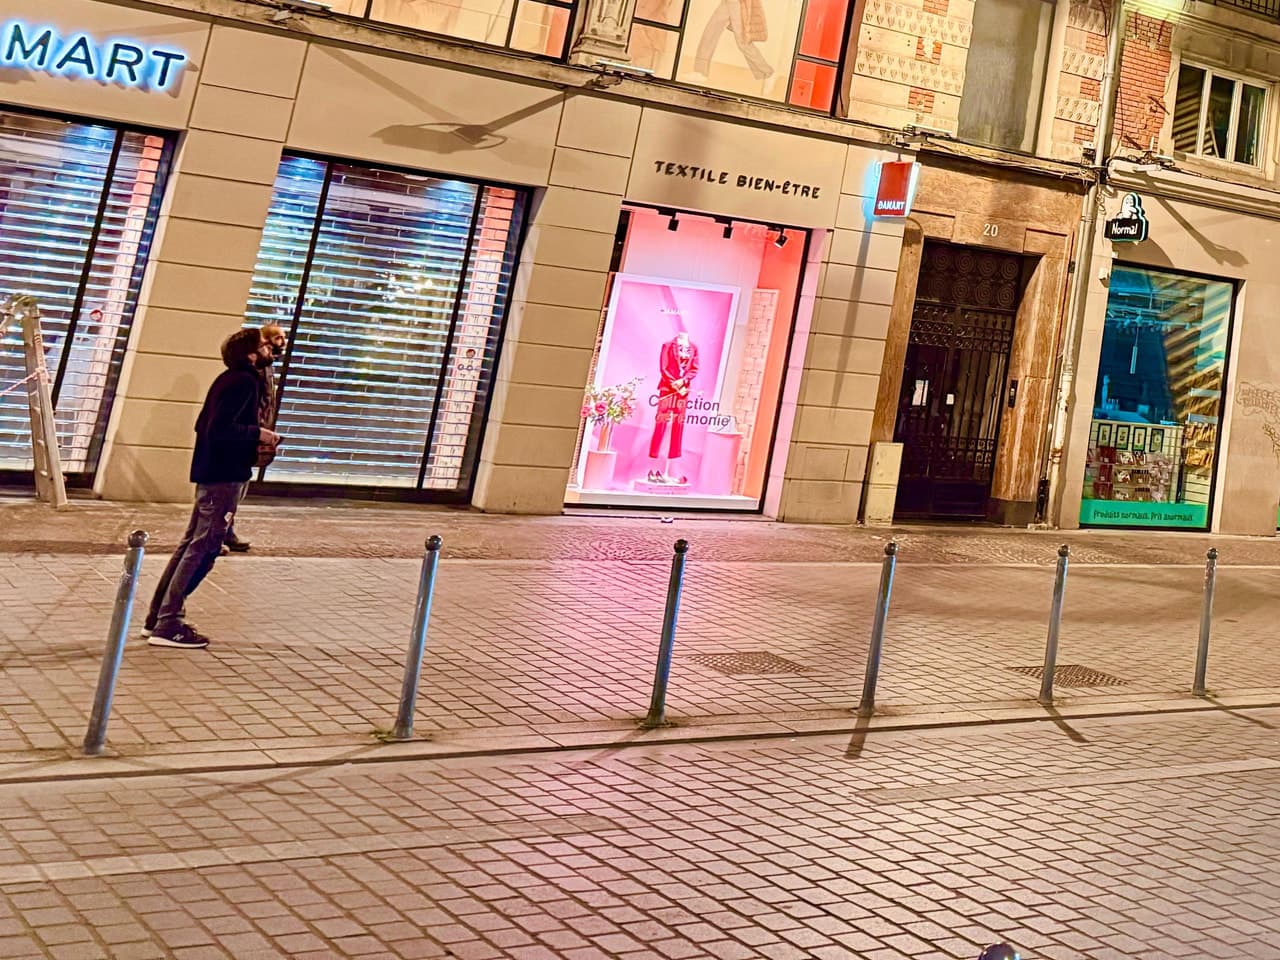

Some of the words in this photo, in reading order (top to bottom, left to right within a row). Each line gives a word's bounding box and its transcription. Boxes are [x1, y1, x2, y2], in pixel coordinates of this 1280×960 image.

[5, 24, 185, 86] MART
[654, 160, 728, 184] TEXTILE
[736, 175, 820, 199] BIEN-ÊTRE
[983, 223, 999, 237] 20
[1111, 222, 1139, 236] Normal
